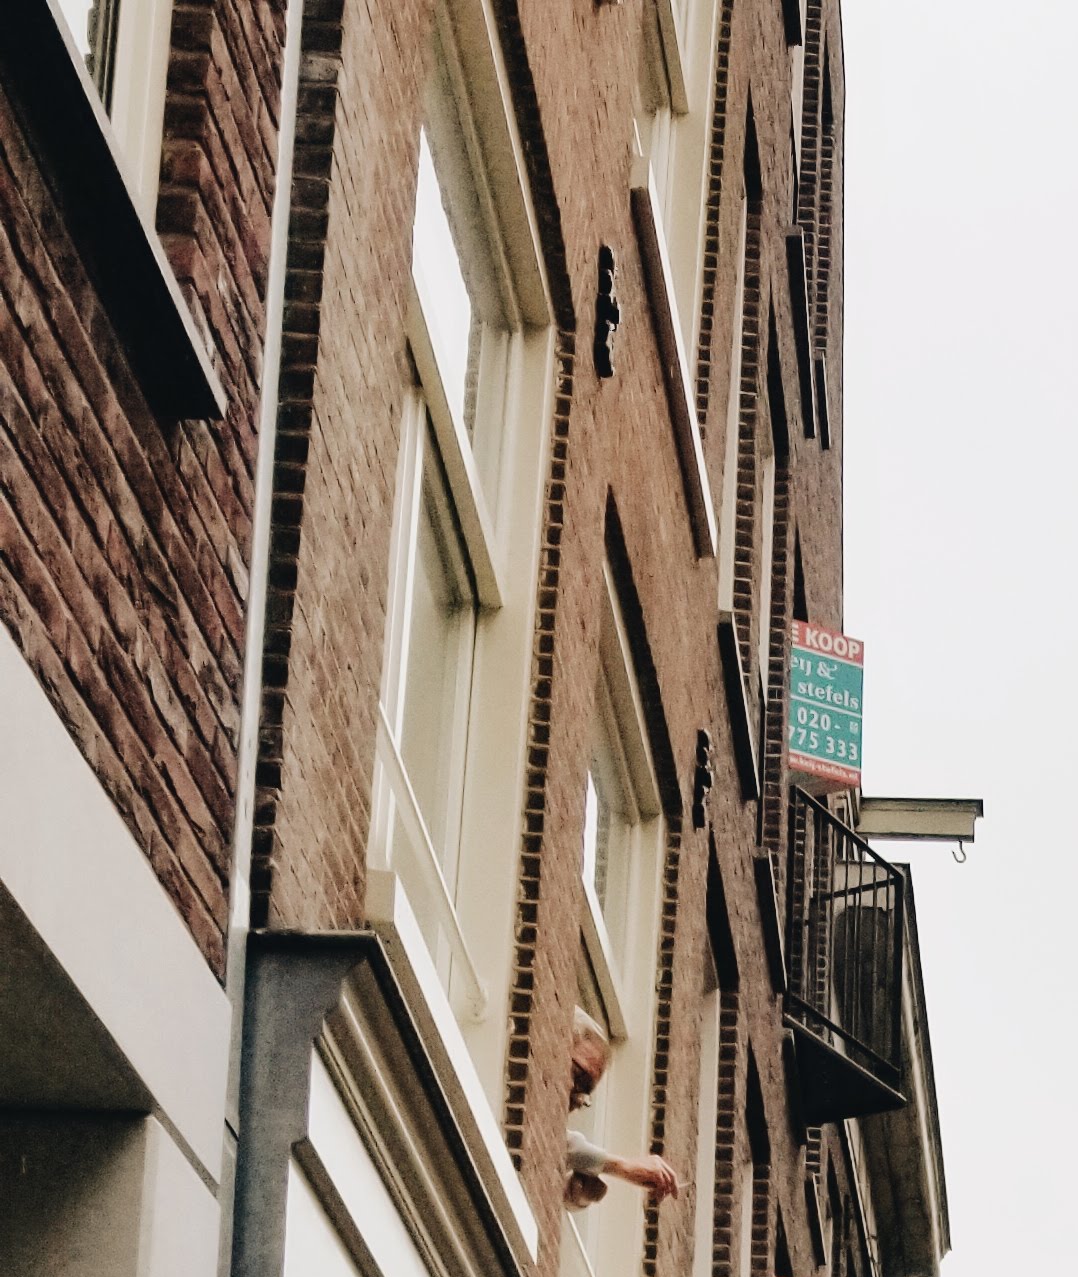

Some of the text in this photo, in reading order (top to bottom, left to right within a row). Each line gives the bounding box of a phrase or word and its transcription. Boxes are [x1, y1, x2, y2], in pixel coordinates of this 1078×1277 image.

[805, 627, 860, 659] KOOP
[817, 661, 838, 680] &
[798, 681, 859, 710] stefels
[825, 735, 858, 760] 333
